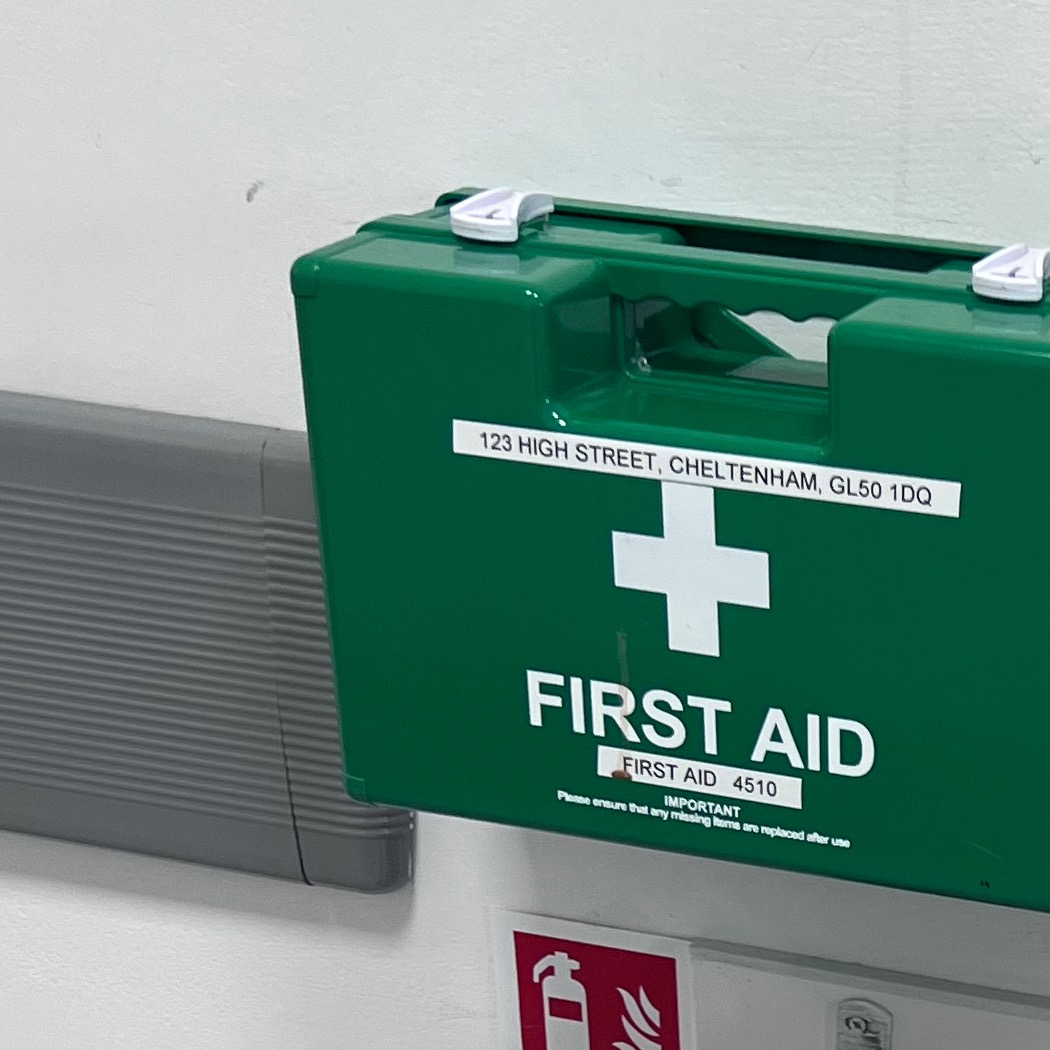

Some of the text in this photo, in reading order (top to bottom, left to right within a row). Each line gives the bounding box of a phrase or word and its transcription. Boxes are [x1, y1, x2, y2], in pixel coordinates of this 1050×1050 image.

[480, 431, 932, 506] 123 HIGH STREET, CHELTENHAM, GL50 1DQ
[526, 669, 875, 778] FIRST AID
[623, 756, 777, 797] FIRST AID 4510
[558, 790, 850, 849] Please ensure that any missing items are replaced after use
[664, 795, 741, 818] IMPORTANT
